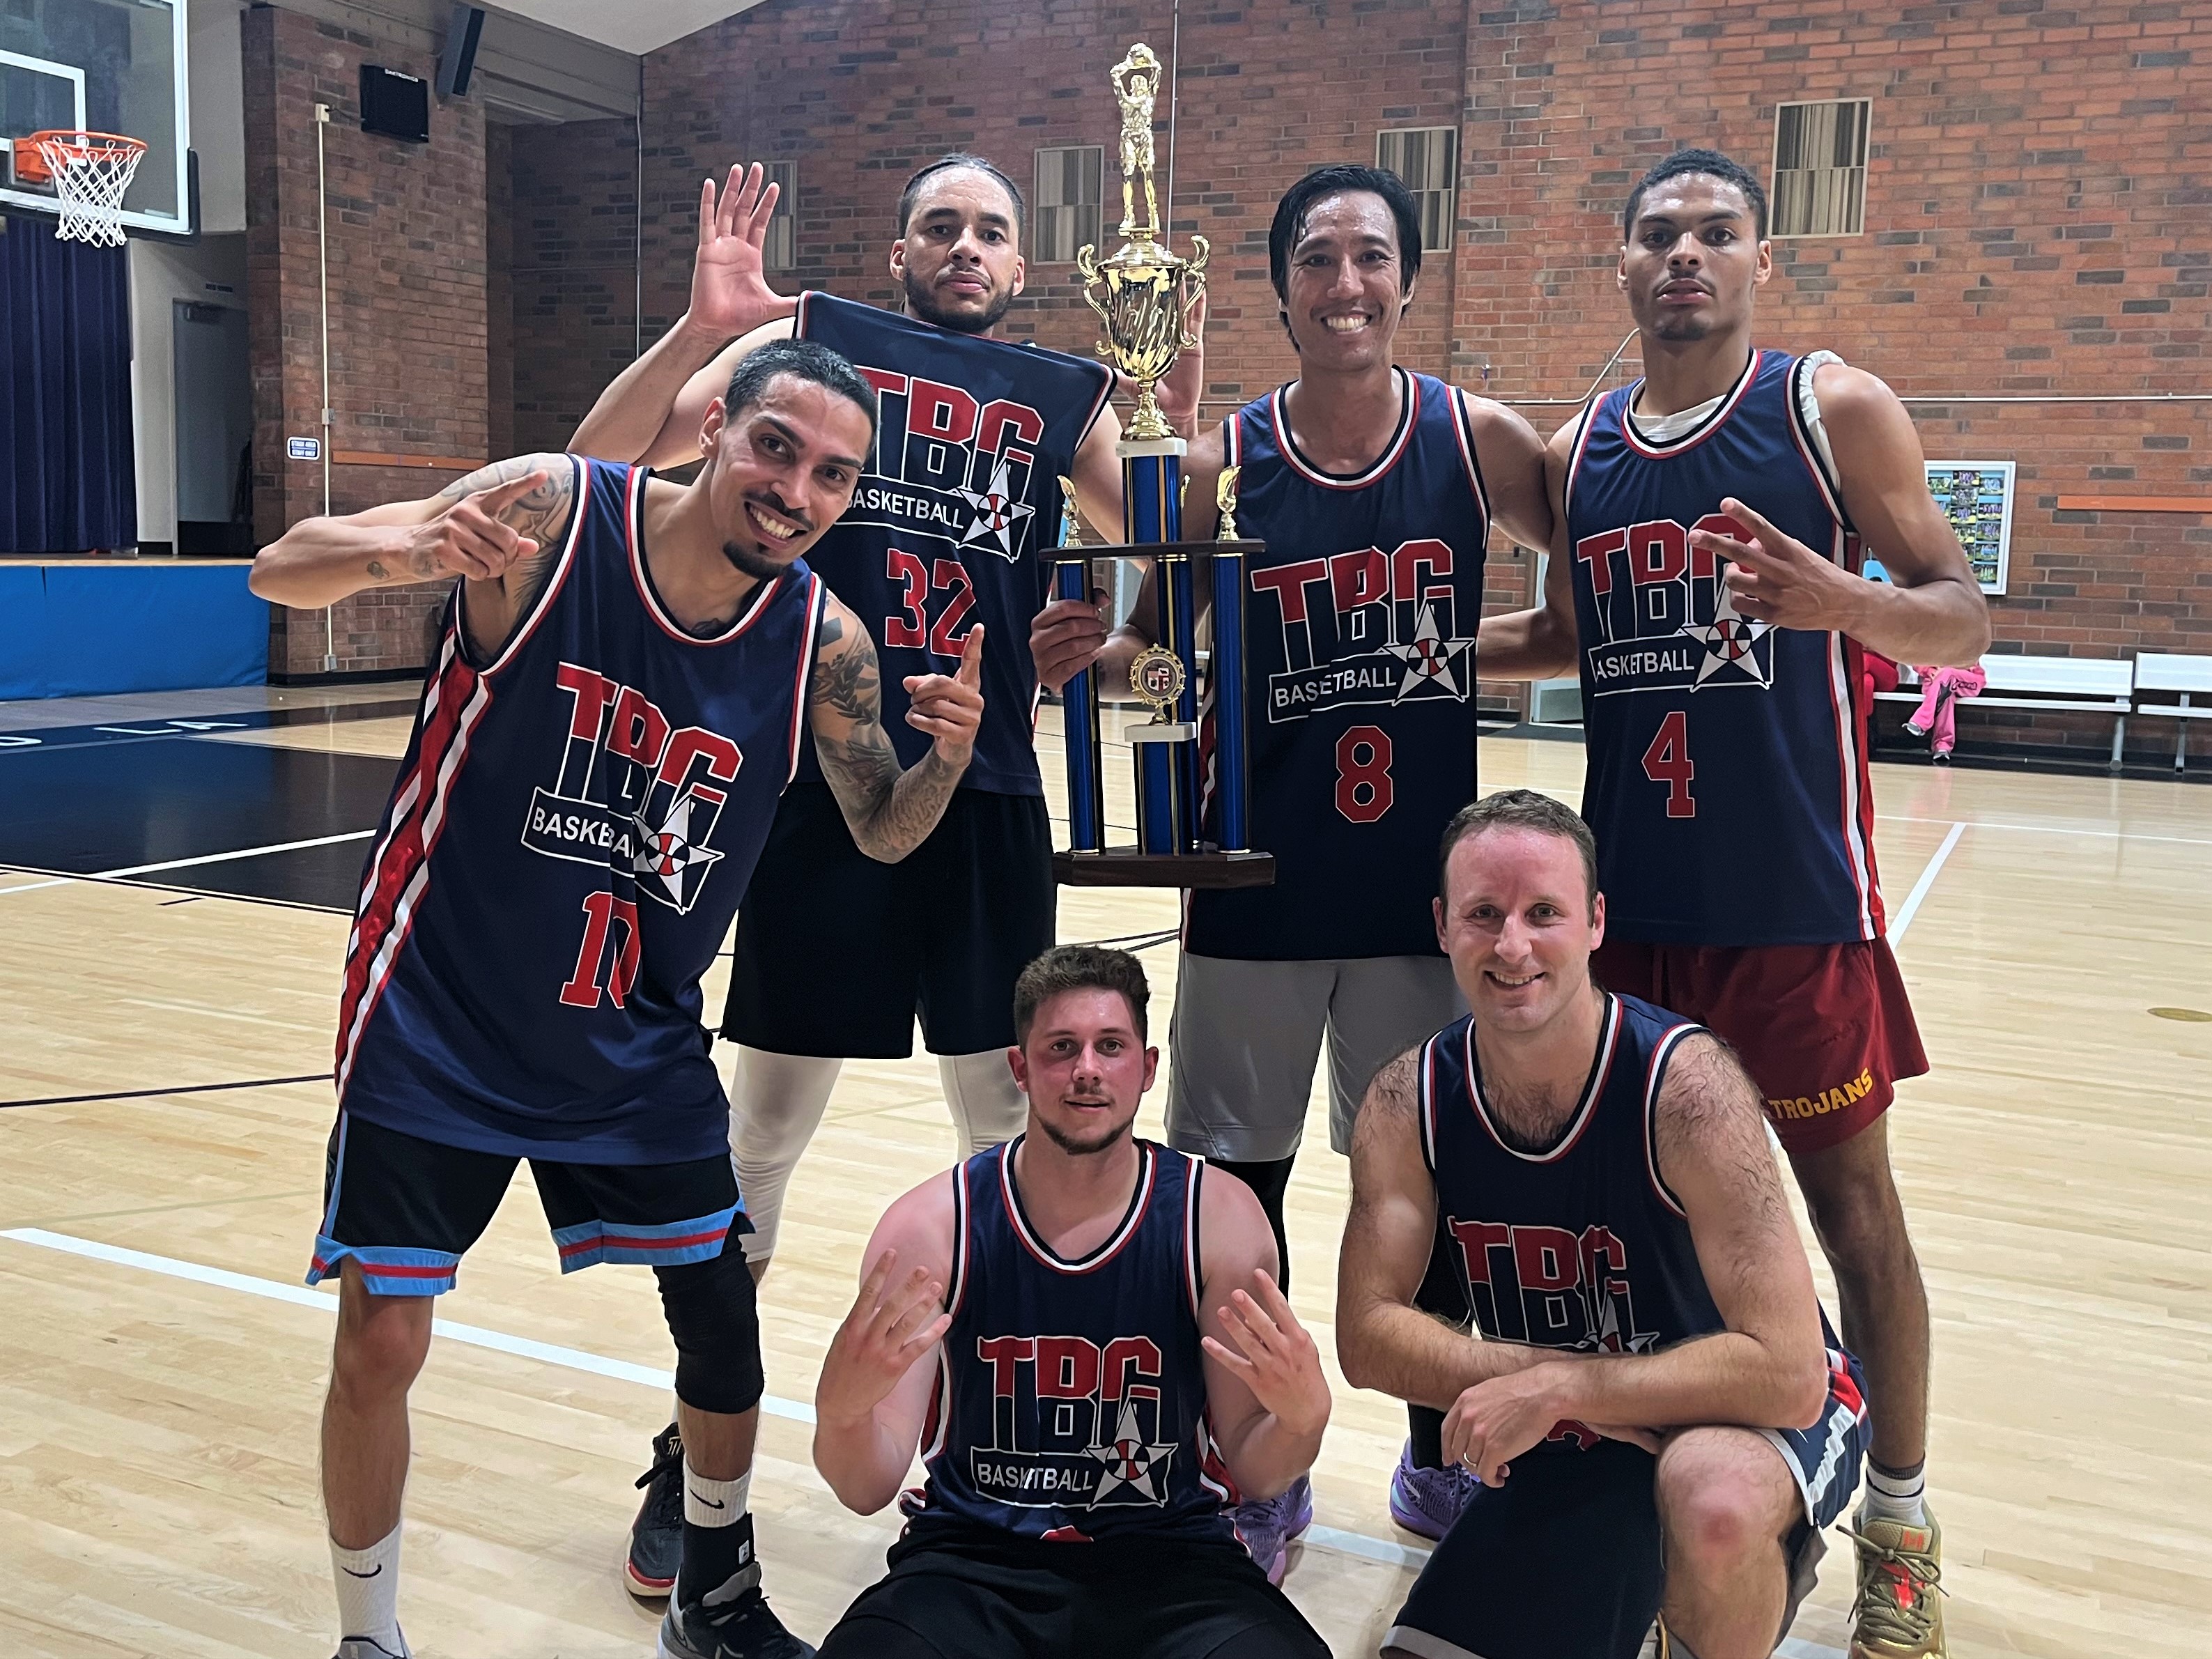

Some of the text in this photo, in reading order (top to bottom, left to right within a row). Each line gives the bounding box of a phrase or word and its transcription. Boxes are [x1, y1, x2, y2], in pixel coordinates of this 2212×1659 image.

[885, 548, 976, 657] 32
[1251, 539, 1453, 674] TBG
[1275, 667, 1397, 707] BASETBALL
[1595, 649, 1695, 679] ASKETBALL
[556, 661, 743, 847] TBG
[1336, 725, 1393, 823] 8
[1641, 711, 1695, 818] 4
[560, 891, 641, 1009] 10
[1768, 1067, 1873, 1120] TROJANS
[1447, 1216, 1635, 1341] TBG
[977, 1336, 1161, 1452] TBG
[977, 1463, 1093, 1492] BASKTBALL
